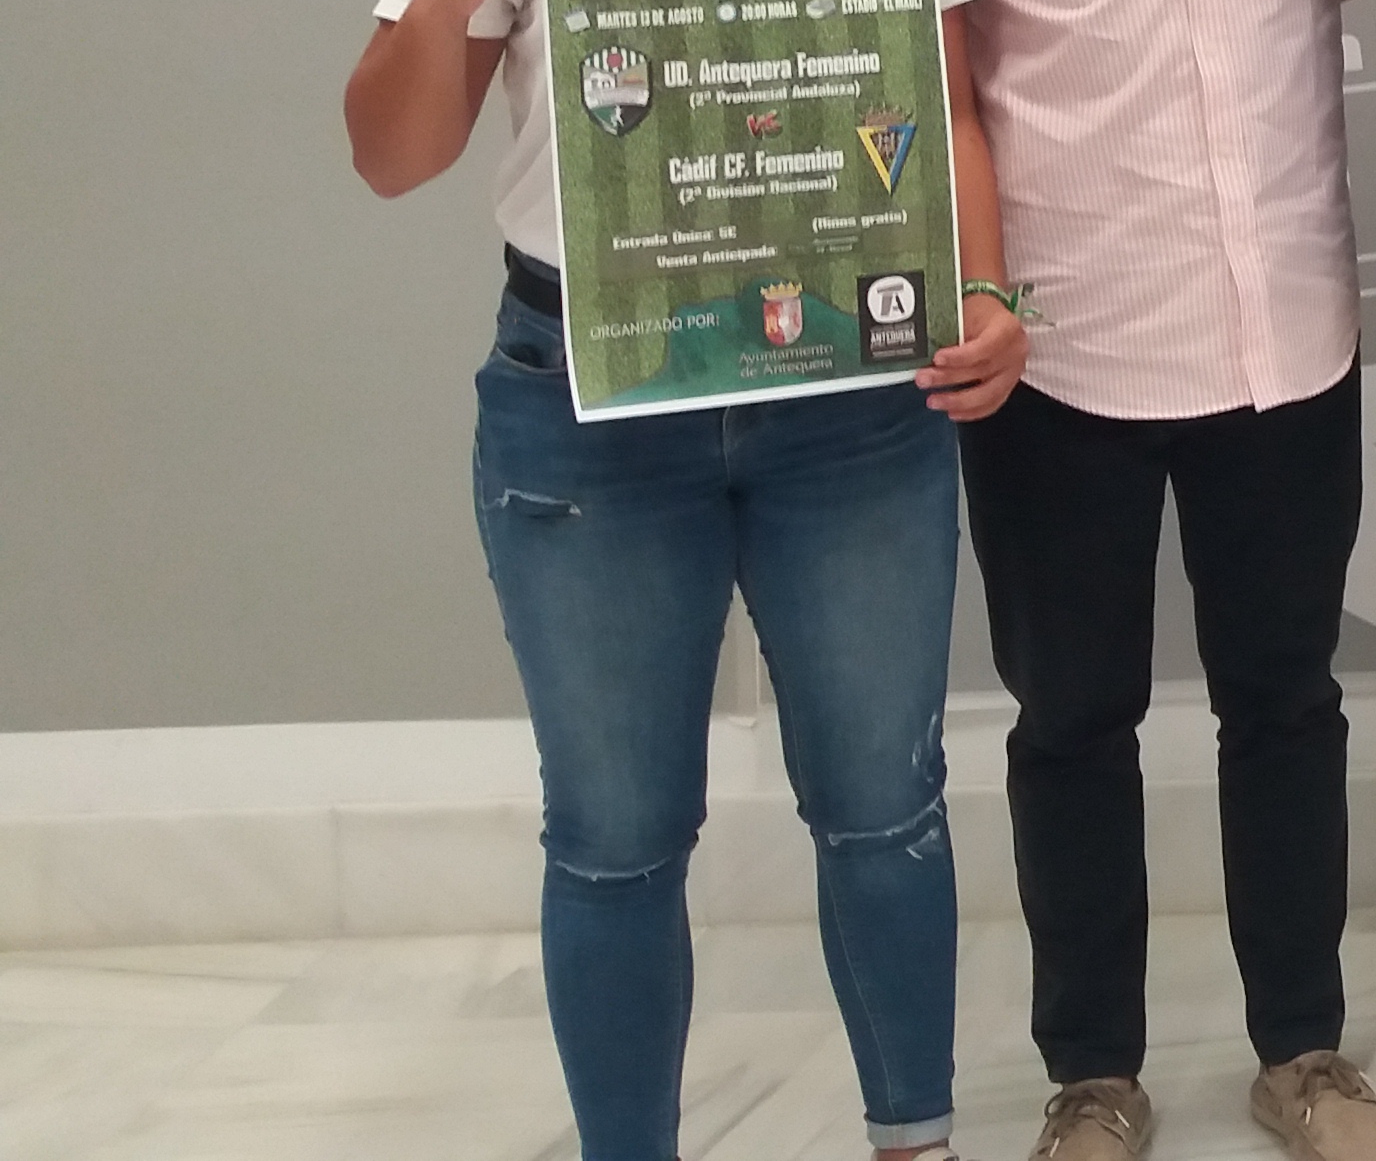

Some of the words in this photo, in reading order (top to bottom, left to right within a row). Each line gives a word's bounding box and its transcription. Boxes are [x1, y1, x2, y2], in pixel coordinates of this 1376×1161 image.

[663, 60, 693, 88] UD.
[698, 53, 792, 89] Antequera
[796, 48, 881, 78] Femenino
[724, 152, 750, 179] CF.
[755, 145, 844, 176] Femenino
